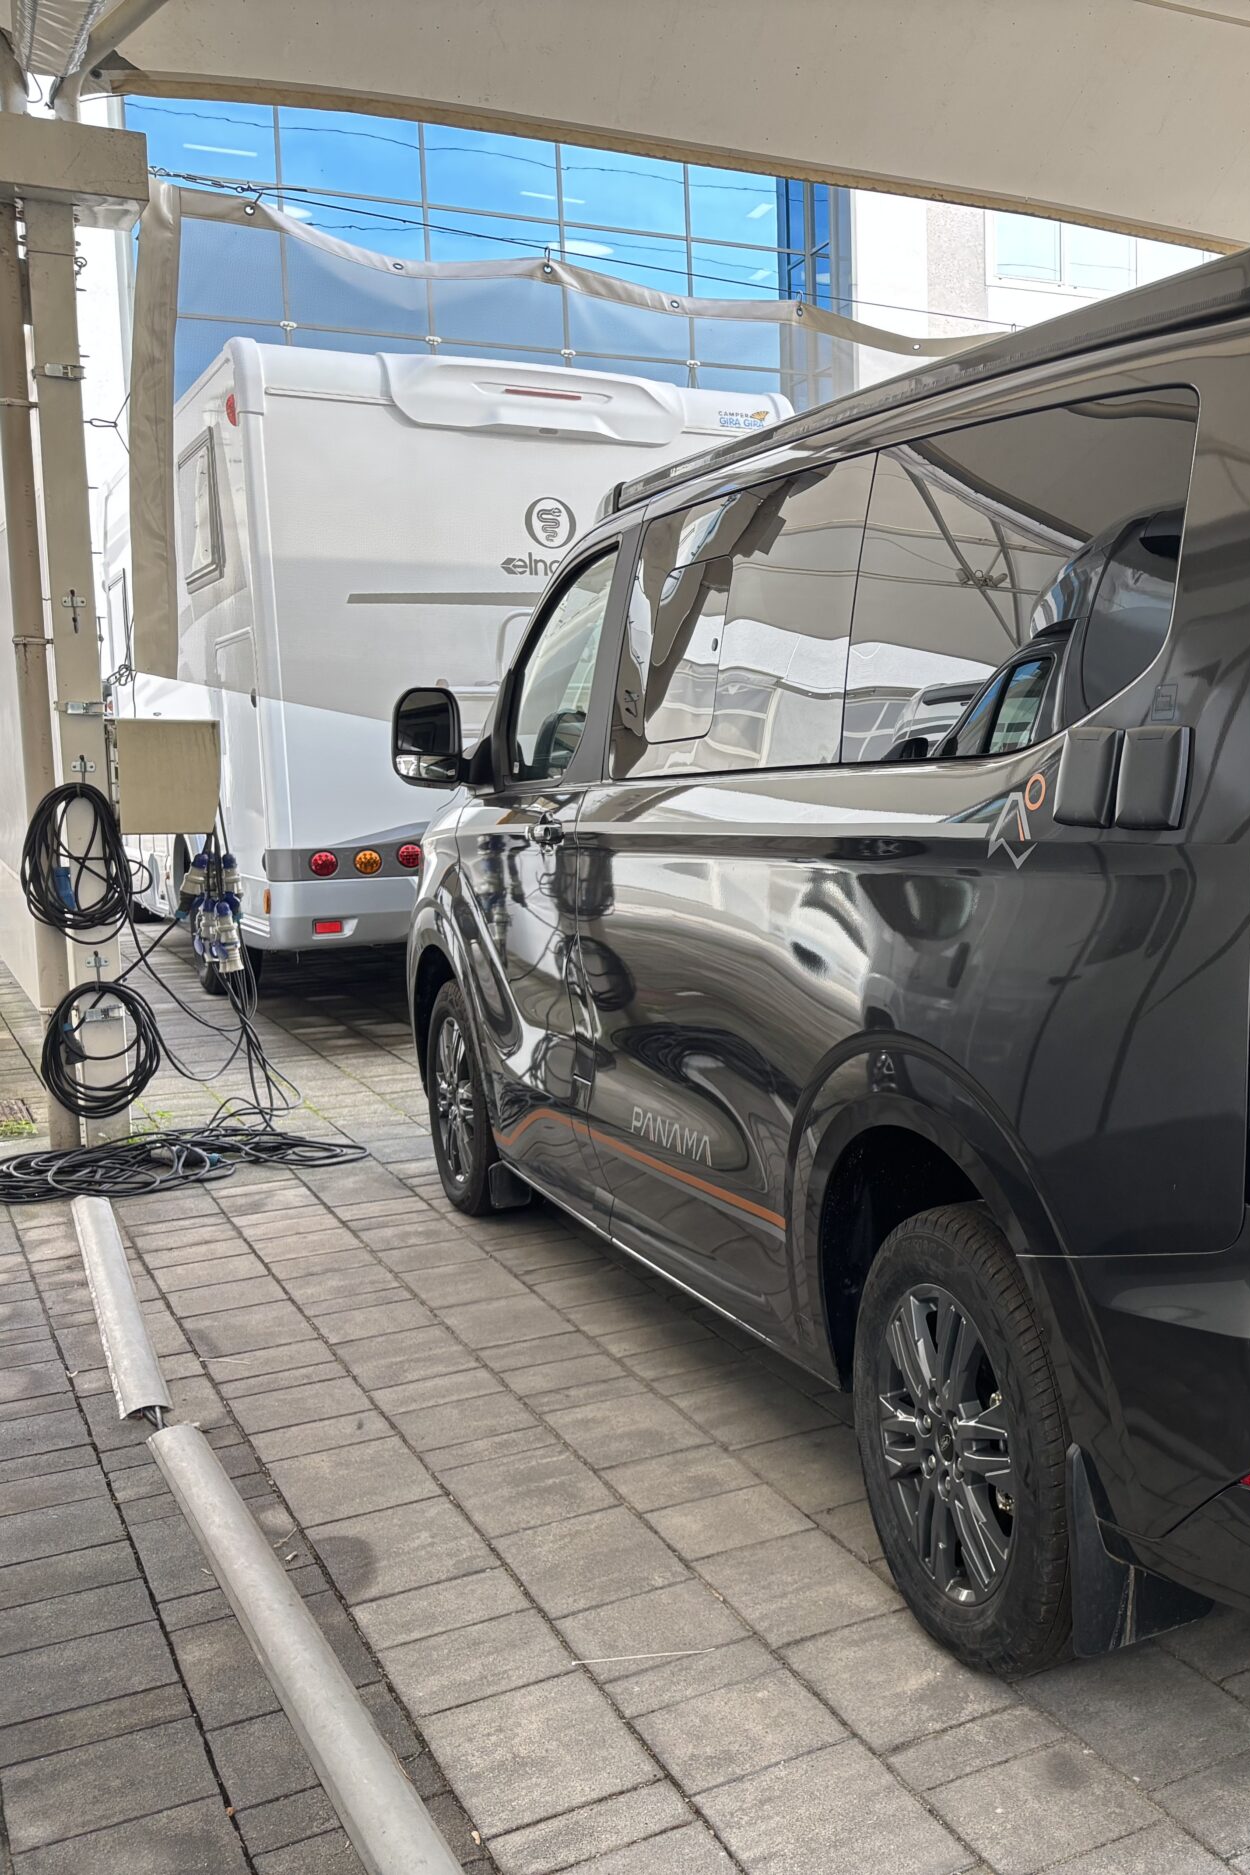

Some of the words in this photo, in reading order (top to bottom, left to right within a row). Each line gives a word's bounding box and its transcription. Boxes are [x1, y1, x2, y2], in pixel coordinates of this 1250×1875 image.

[718, 410, 749, 418] CAMPER
[719, 416, 741, 427] GIRA
[631, 1105, 712, 1167] PANAMA
